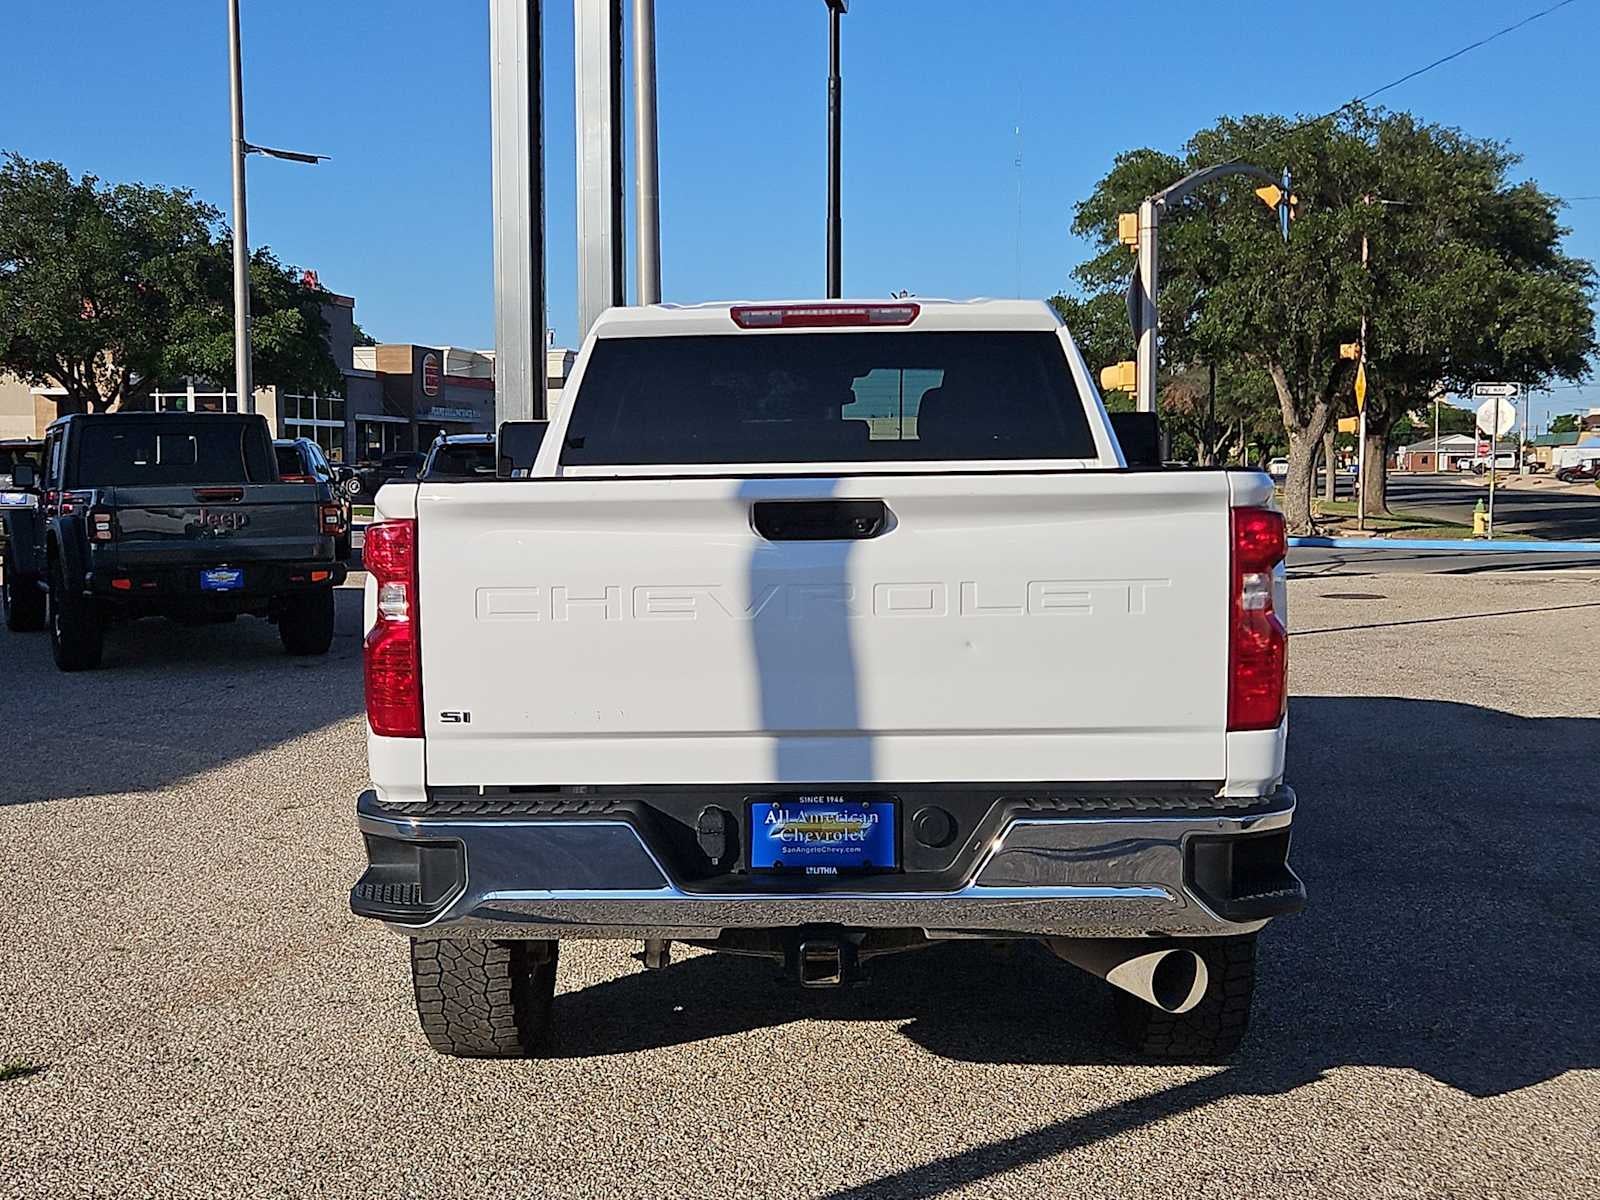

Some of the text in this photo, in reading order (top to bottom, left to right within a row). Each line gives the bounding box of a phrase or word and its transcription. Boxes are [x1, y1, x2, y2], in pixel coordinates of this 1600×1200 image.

[197, 508, 246, 529] Jeep
[475, 578, 1172, 622] CHEVROLET
[799, 796, 844, 804] SINCE 1946
[765, 810, 879, 824] All American
[780, 827, 865, 842] Chevrolet
[782, 847, 861, 855] SanAngeloChevy.com
